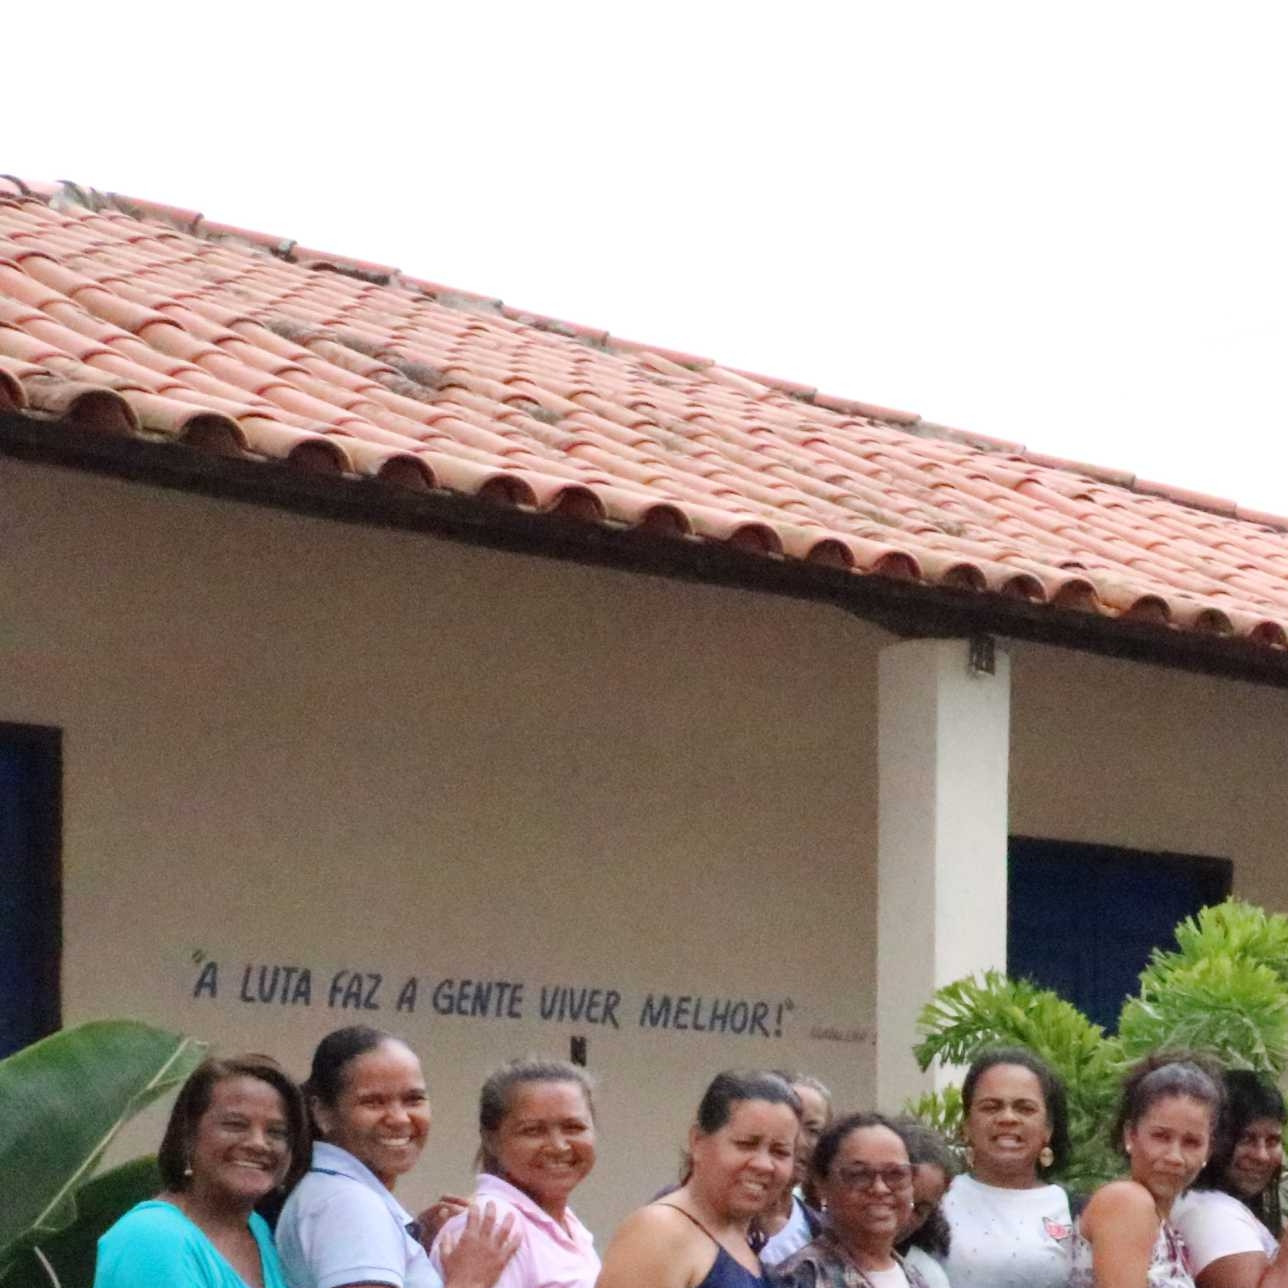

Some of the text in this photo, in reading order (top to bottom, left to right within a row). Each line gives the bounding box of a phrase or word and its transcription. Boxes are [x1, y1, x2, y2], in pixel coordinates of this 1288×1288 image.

[240, 963, 312, 1007] LUTA
[327, 968, 383, 1011] FAZ
[396, 977, 418, 1013] A
[432, 977, 524, 1019] GENTE
[540, 986, 621, 1029] VIVER
